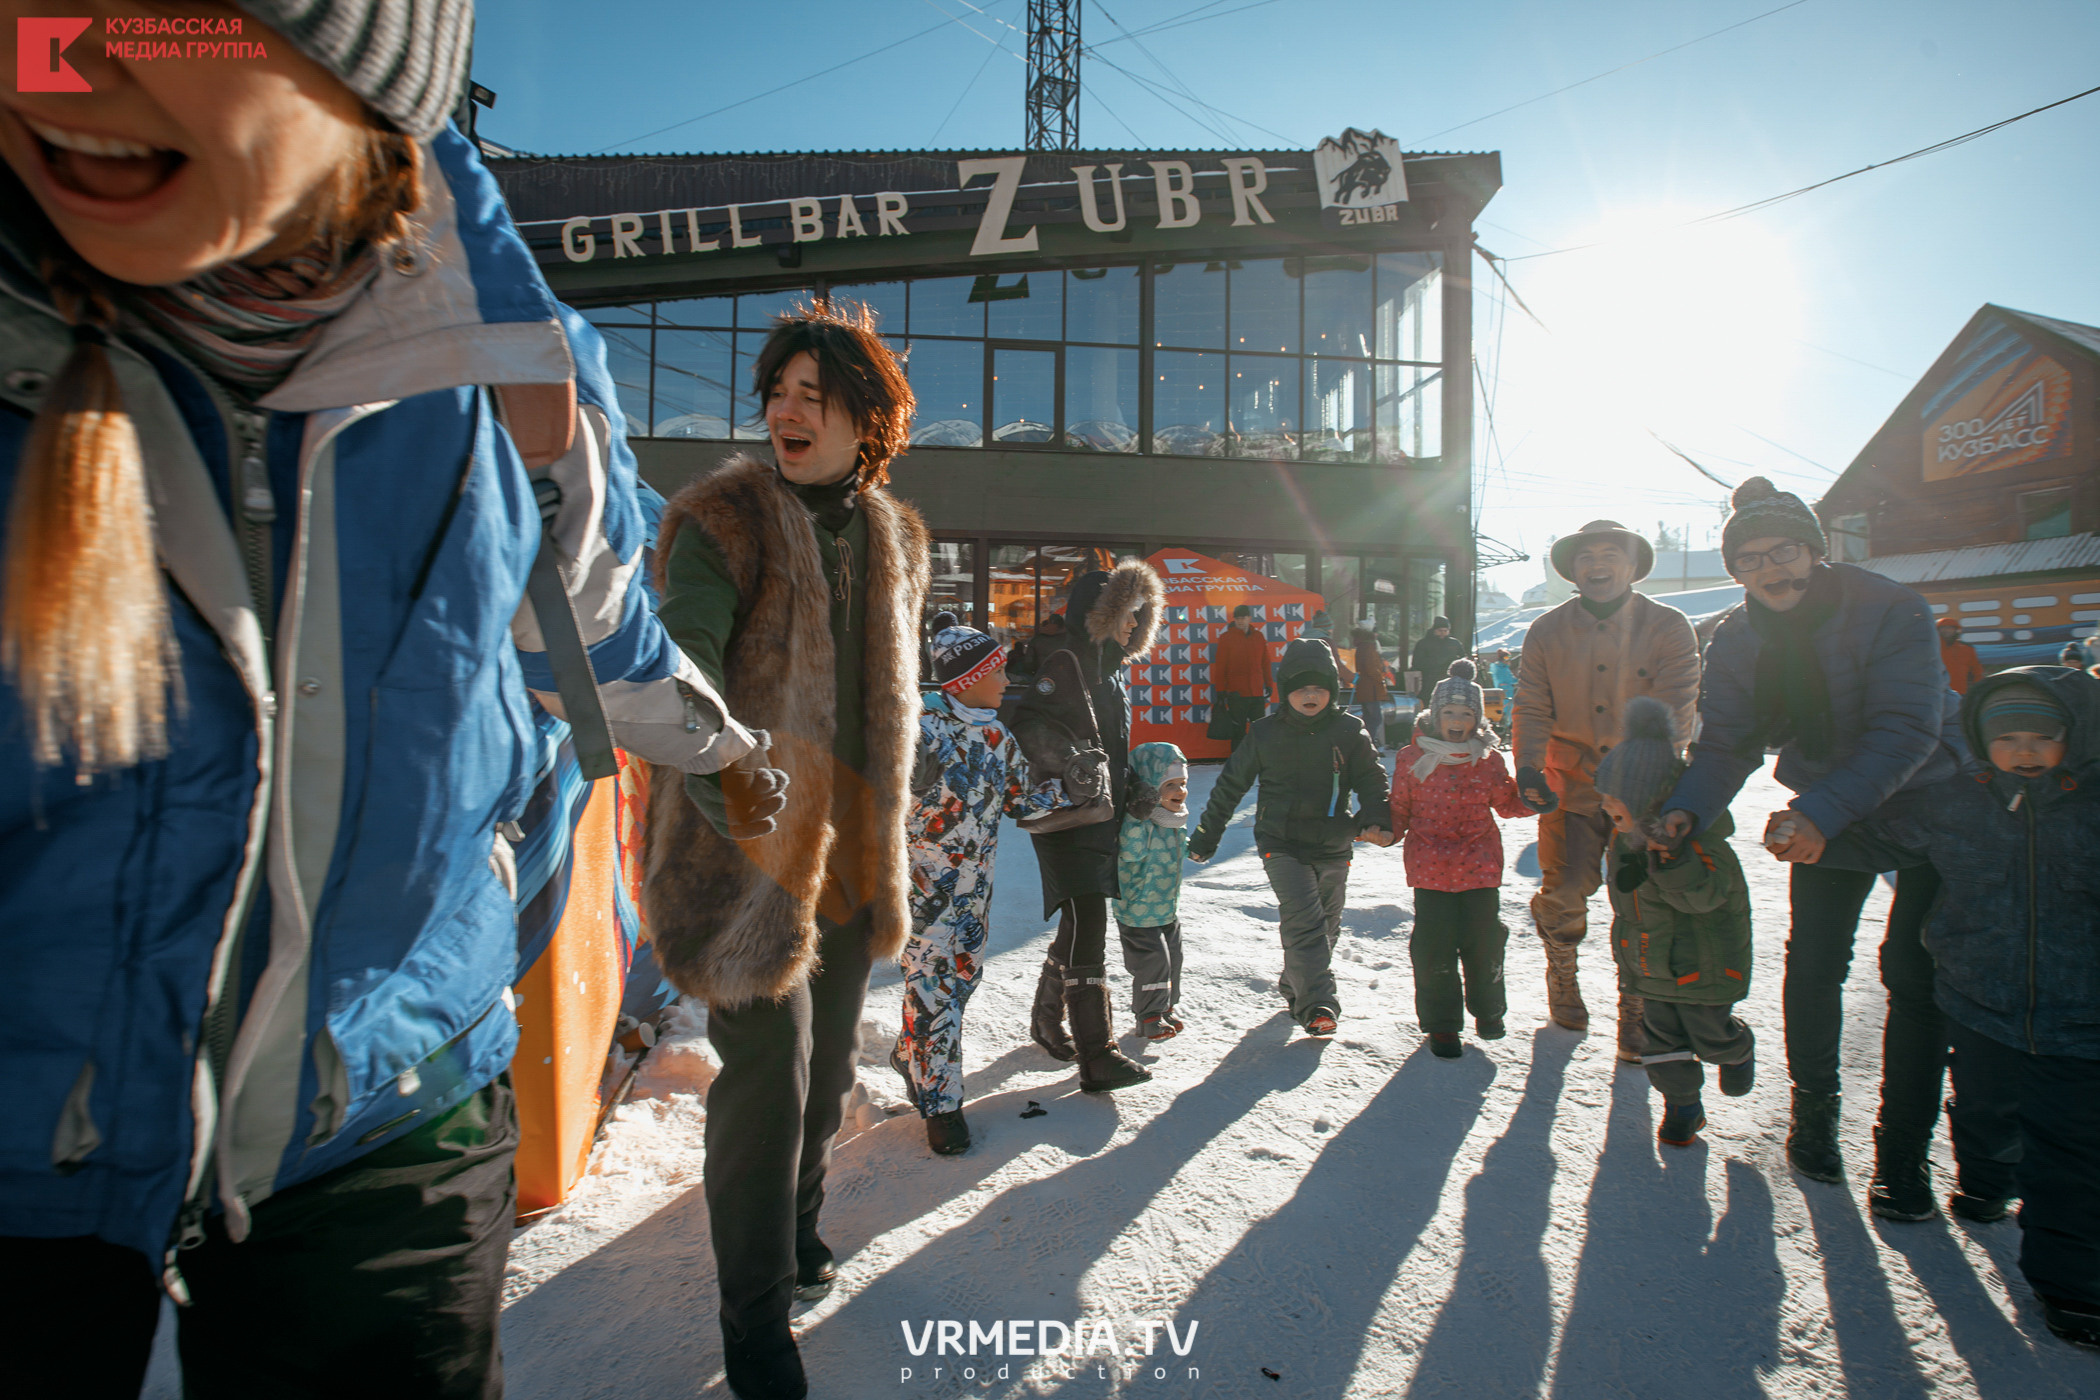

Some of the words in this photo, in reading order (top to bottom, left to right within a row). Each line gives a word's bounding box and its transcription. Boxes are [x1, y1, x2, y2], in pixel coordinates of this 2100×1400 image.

[561, 208, 762, 263] GRILL
[789, 192, 911, 244] BAR
[957, 155, 1276, 256] ZUBR
[1338, 204, 1399, 226] ZUBR
[1937, 418, 1984, 443] 300
[1937, 425, 2050, 463] КУЗБАСС
[1160, 576, 1249, 584] ЗБАССКАЯ
[1195, 584, 1265, 592] ГРУППА
